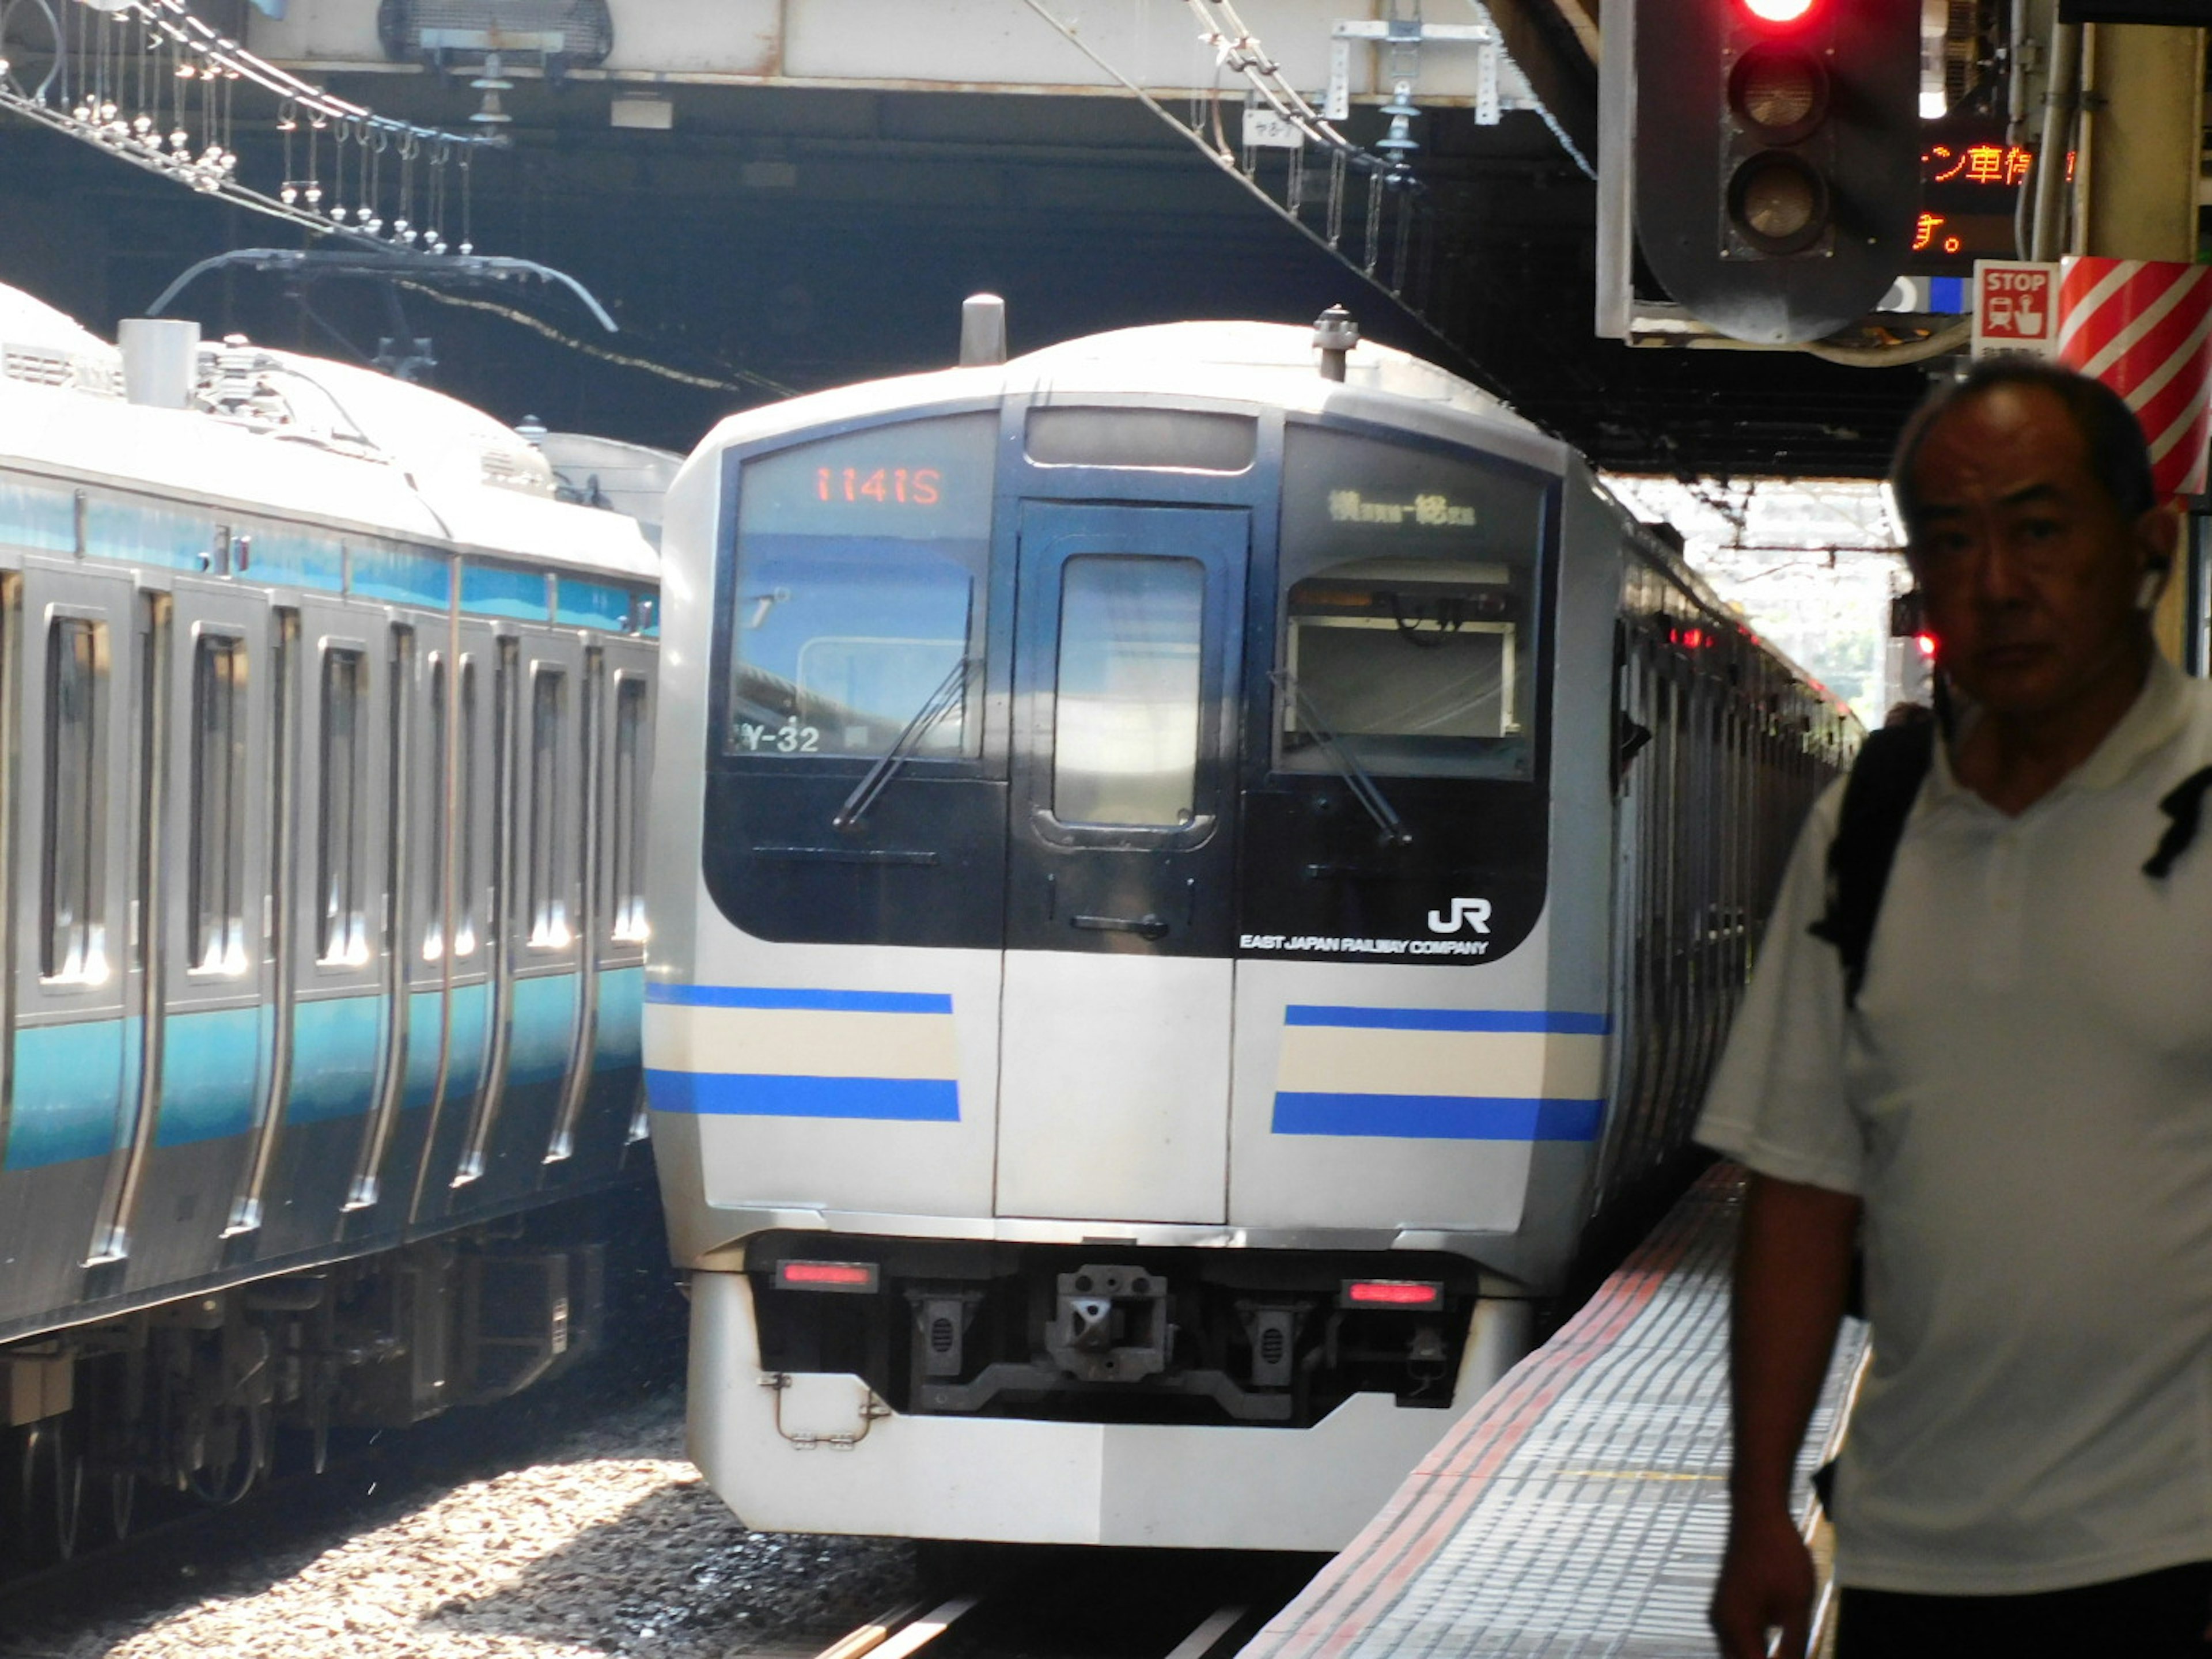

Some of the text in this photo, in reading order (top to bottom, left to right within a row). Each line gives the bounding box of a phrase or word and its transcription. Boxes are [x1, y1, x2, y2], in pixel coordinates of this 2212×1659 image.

[1987, 272, 2046, 291] STOP
[817, 467, 941, 505] 1141S
[741, 724, 819, 752] Y-32
[1427, 897, 1491, 934] JR
[1239, 934, 1490, 956] EAST JAPAN RAILWAY COMPANY
